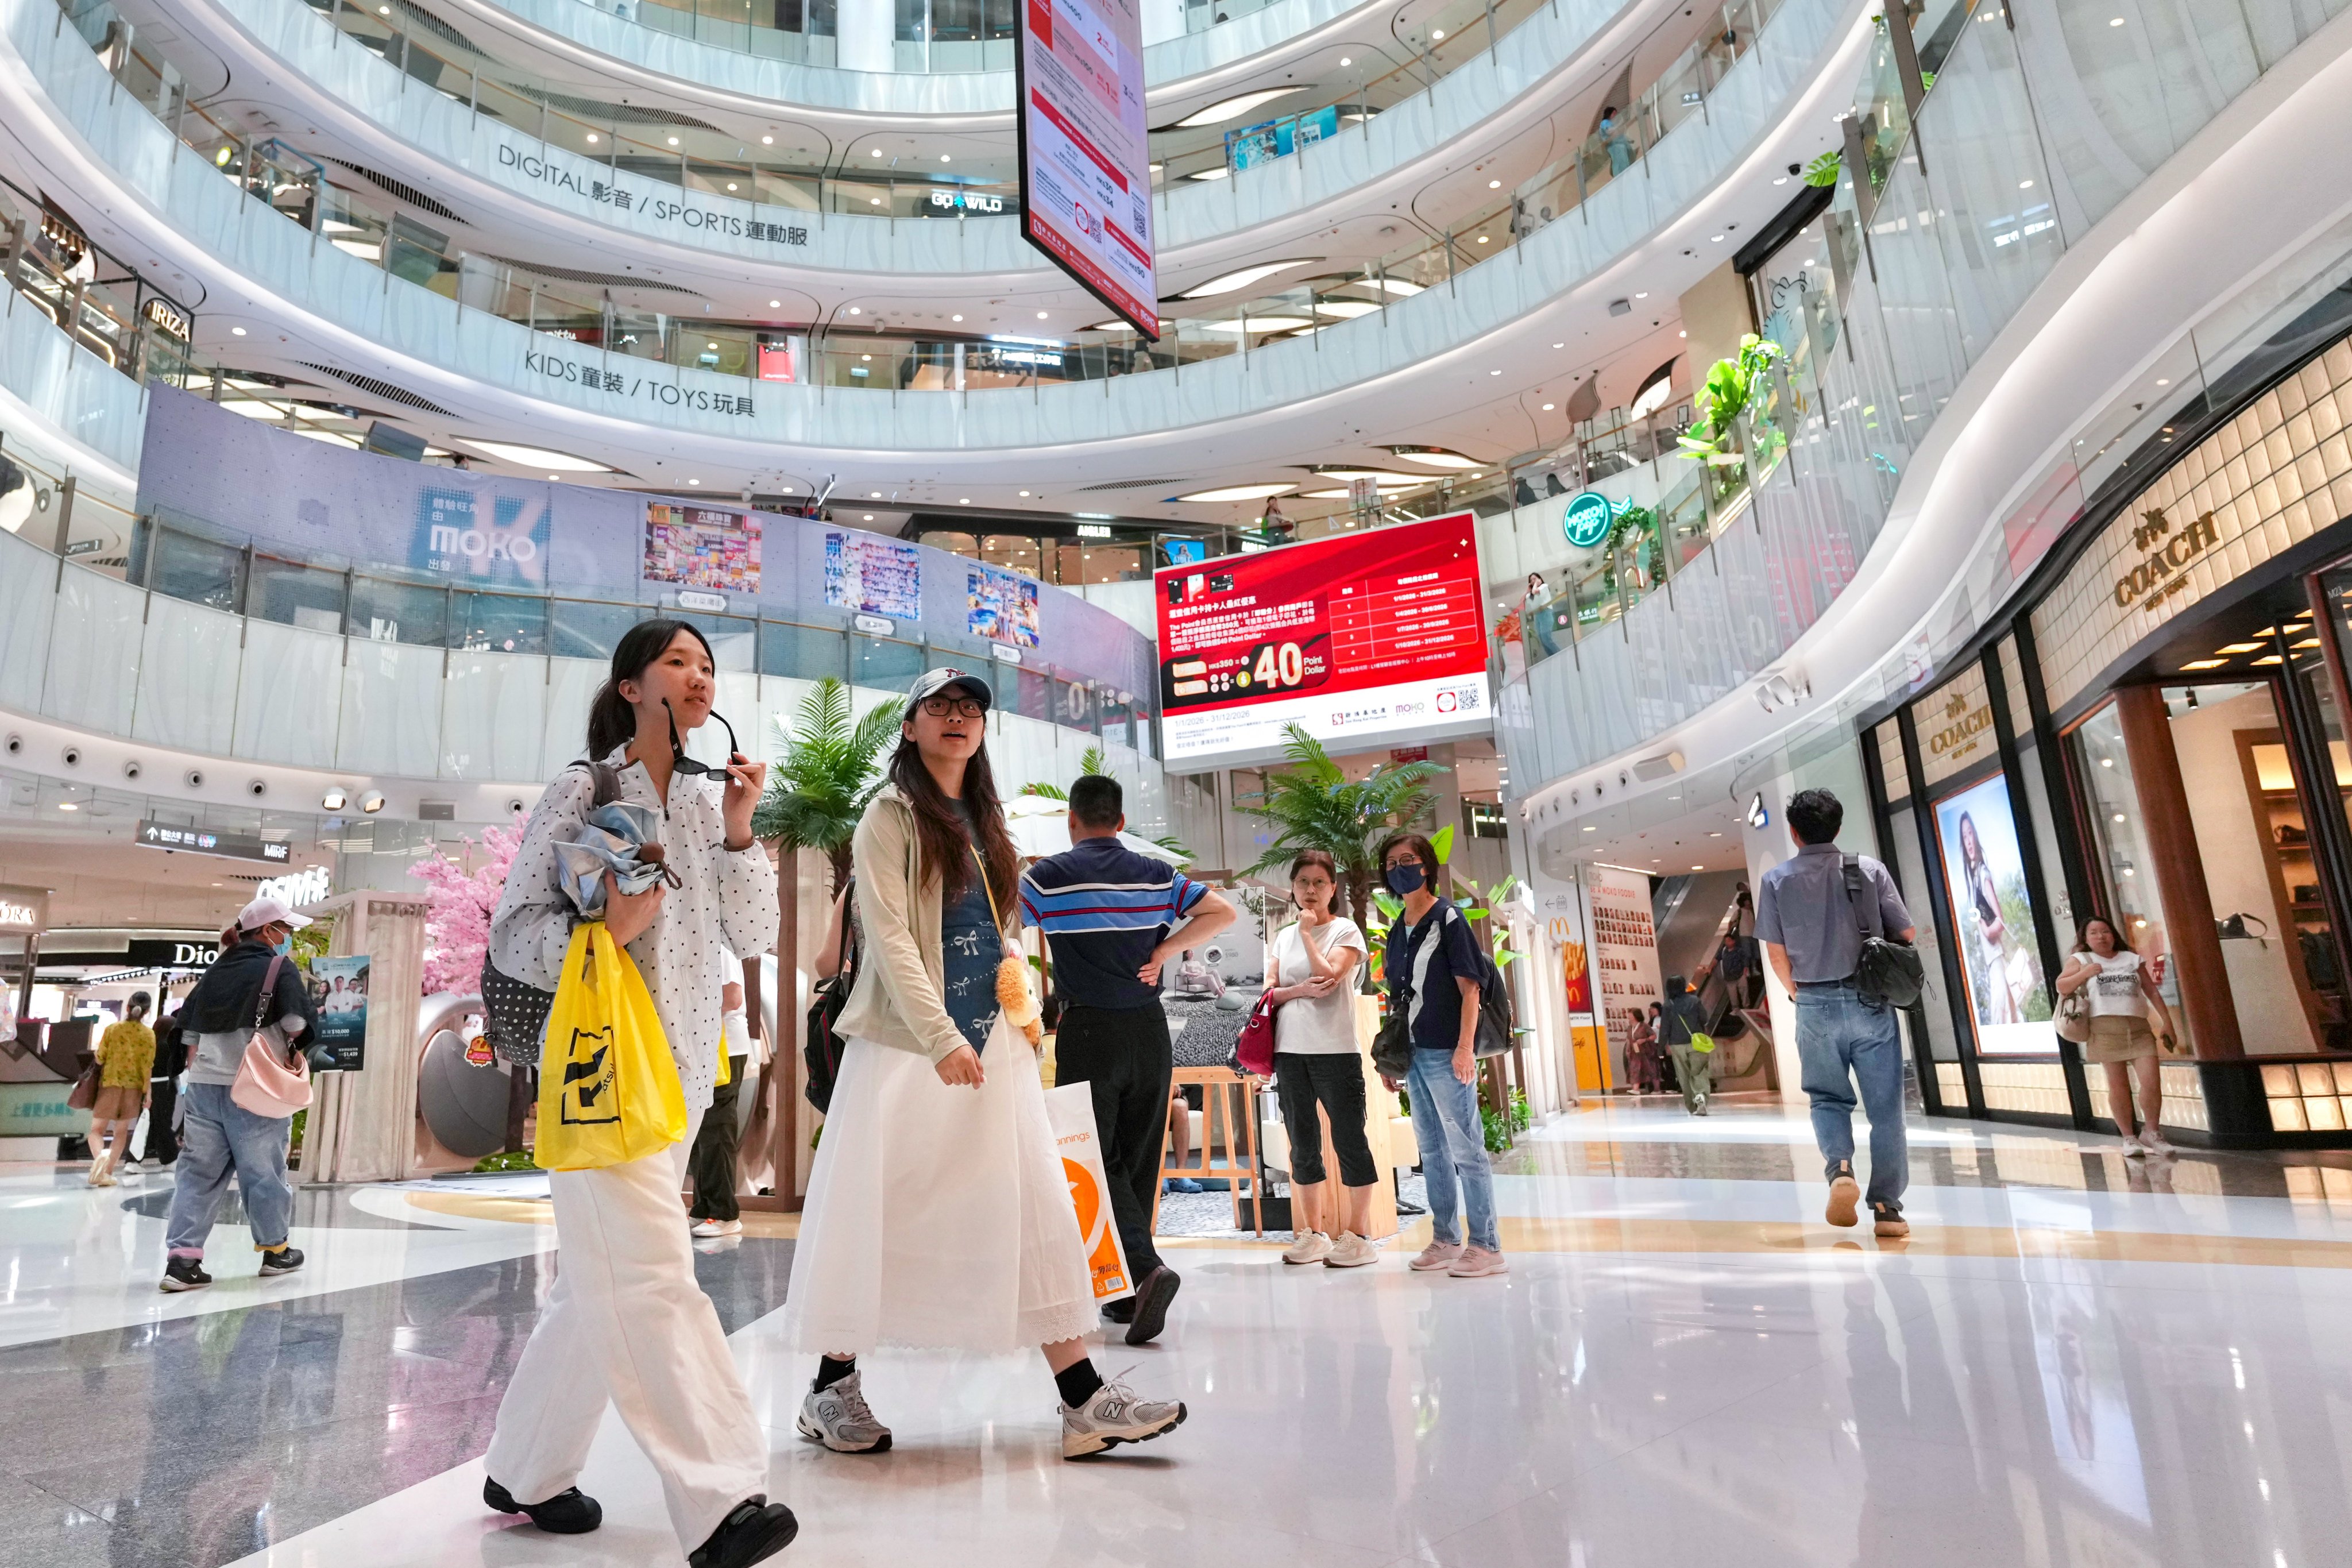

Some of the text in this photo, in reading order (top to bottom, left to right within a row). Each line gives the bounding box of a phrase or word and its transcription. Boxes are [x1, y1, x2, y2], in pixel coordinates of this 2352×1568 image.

[499, 144, 808, 246] DIGITAL 影音 / SPORTS 運動服
[932, 193, 1002, 212] GO WILD
[151, 301, 190, 343] IRIZA
[525, 350, 755, 418] KIDS 童裝 / TOYS 玩具
[432, 511, 443, 522] 由
[430, 524, 536, 562] MOKO
[428, 558, 451, 572] 出發
[2114, 511, 2220, 608] COACH
[1208, 659, 1234, 670] HK$350
[1254, 642, 1303, 689] 40
[1303, 655, 1323, 666] Point
[1304, 665, 1326, 675] Dollar
[1175, 715, 1204, 727] 1/1/2026
[1211, 710, 1250, 723] 31/12/2026
[1930, 704, 1992, 754] COACH
[256, 870, 313, 909] OSIM
[172, 944, 219, 964] Dio
[822, 1405, 840, 1423] N
[1102, 1401, 1123, 1420] N
